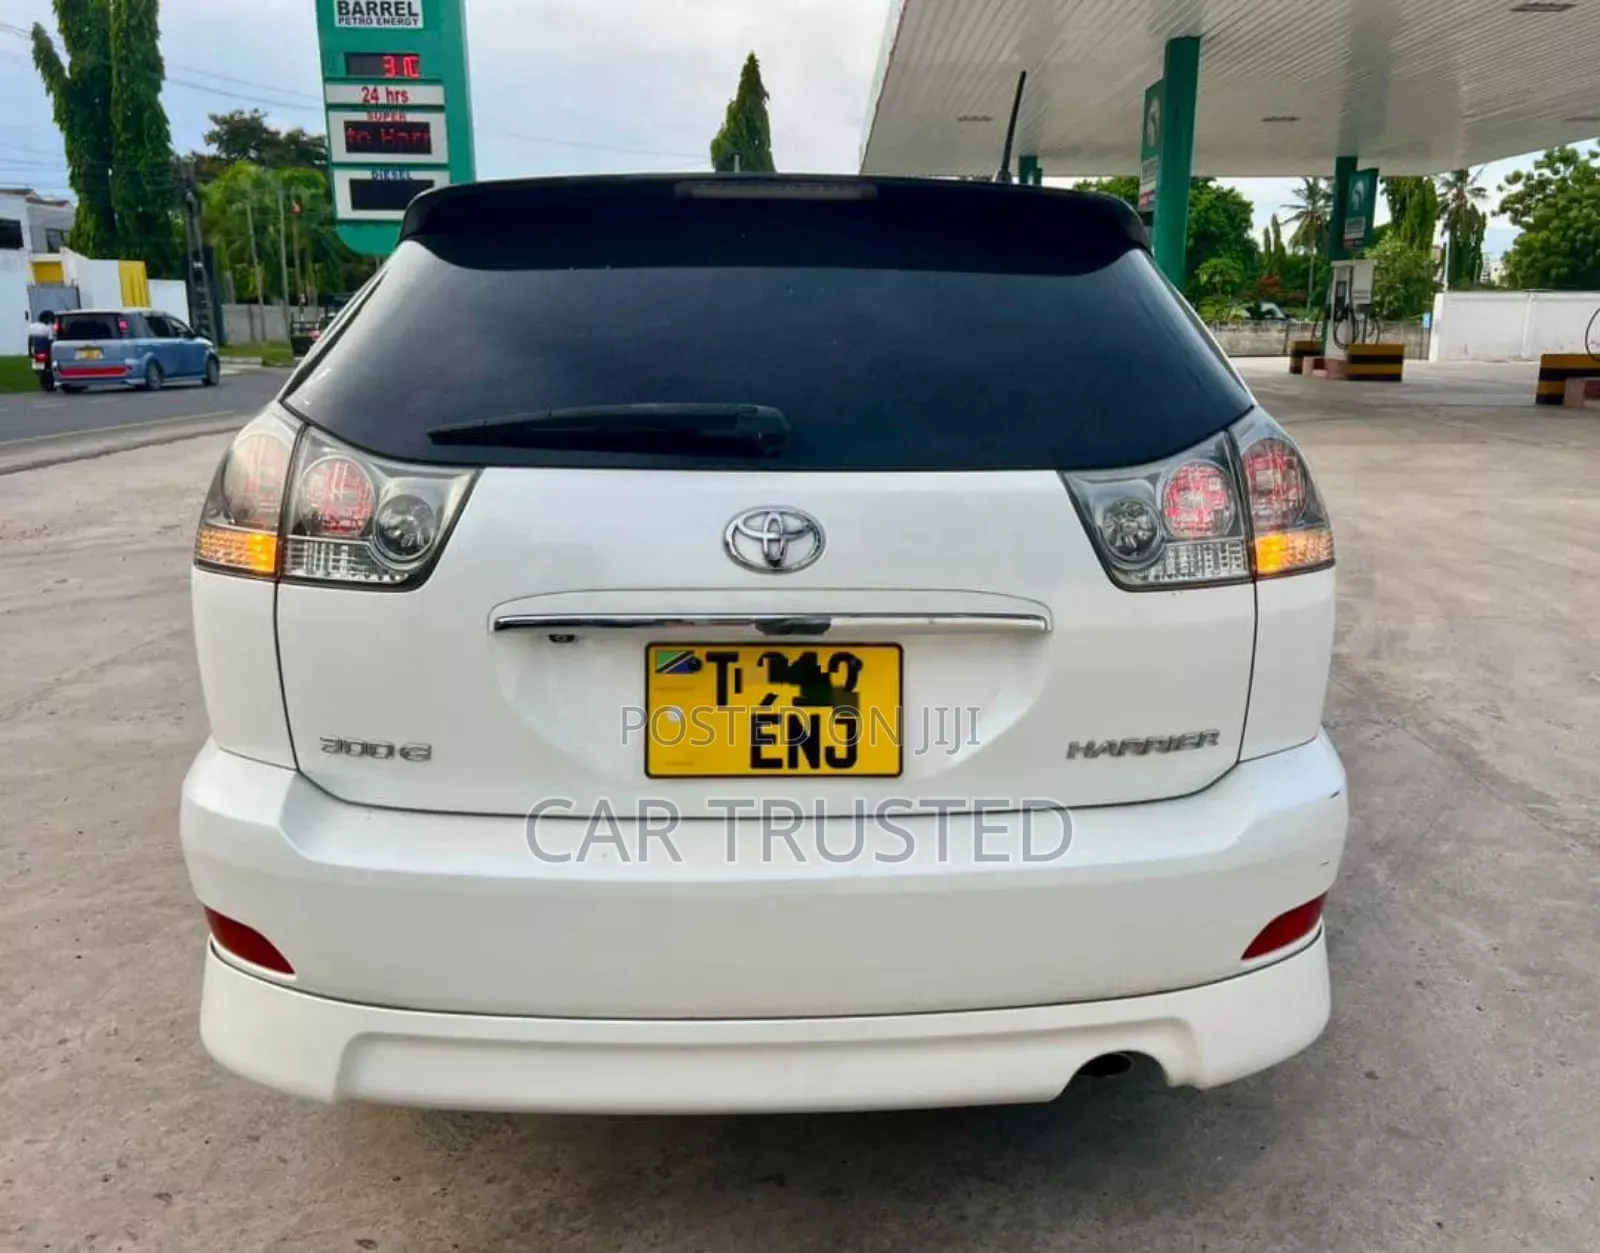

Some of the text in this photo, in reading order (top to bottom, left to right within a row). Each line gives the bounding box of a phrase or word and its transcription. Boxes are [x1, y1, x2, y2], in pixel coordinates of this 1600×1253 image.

[337, 0, 418, 17] BARREL
[338, 16, 419, 26] PETRO ENERGY
[361, 86, 409, 104] 24 hrs
[366, 112, 406, 122] SUPER
[371, 171, 412, 181] DIESEL
[750, 713, 858, 769] ENJ
[1065, 728, 1221, 760] HARRIER
